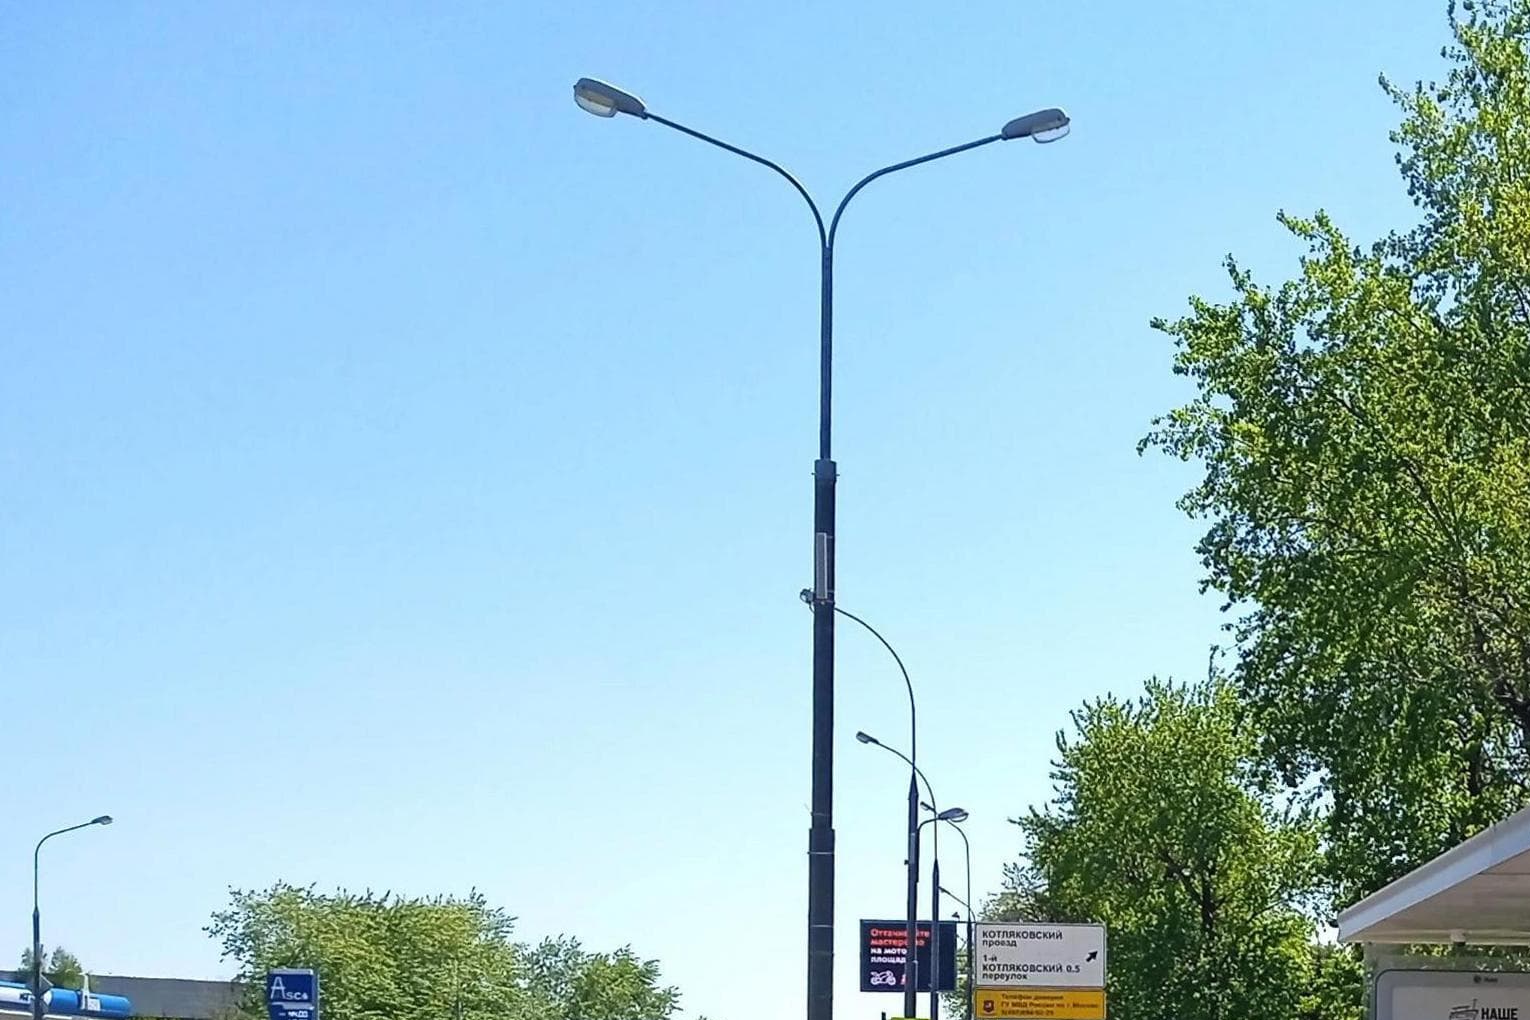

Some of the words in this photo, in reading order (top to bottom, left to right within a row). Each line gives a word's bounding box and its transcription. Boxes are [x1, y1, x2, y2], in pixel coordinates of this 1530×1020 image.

[982, 929, 1063, 940] КОТЛЯКОВСКИЙ
[982, 940, 1017, 948] проезд
[982, 963, 1063, 973] КОТЛЯКОВСКИЙ
[982, 972, 1028, 981] переулок
[1481, 1008, 1518, 1020] НАШЕ
